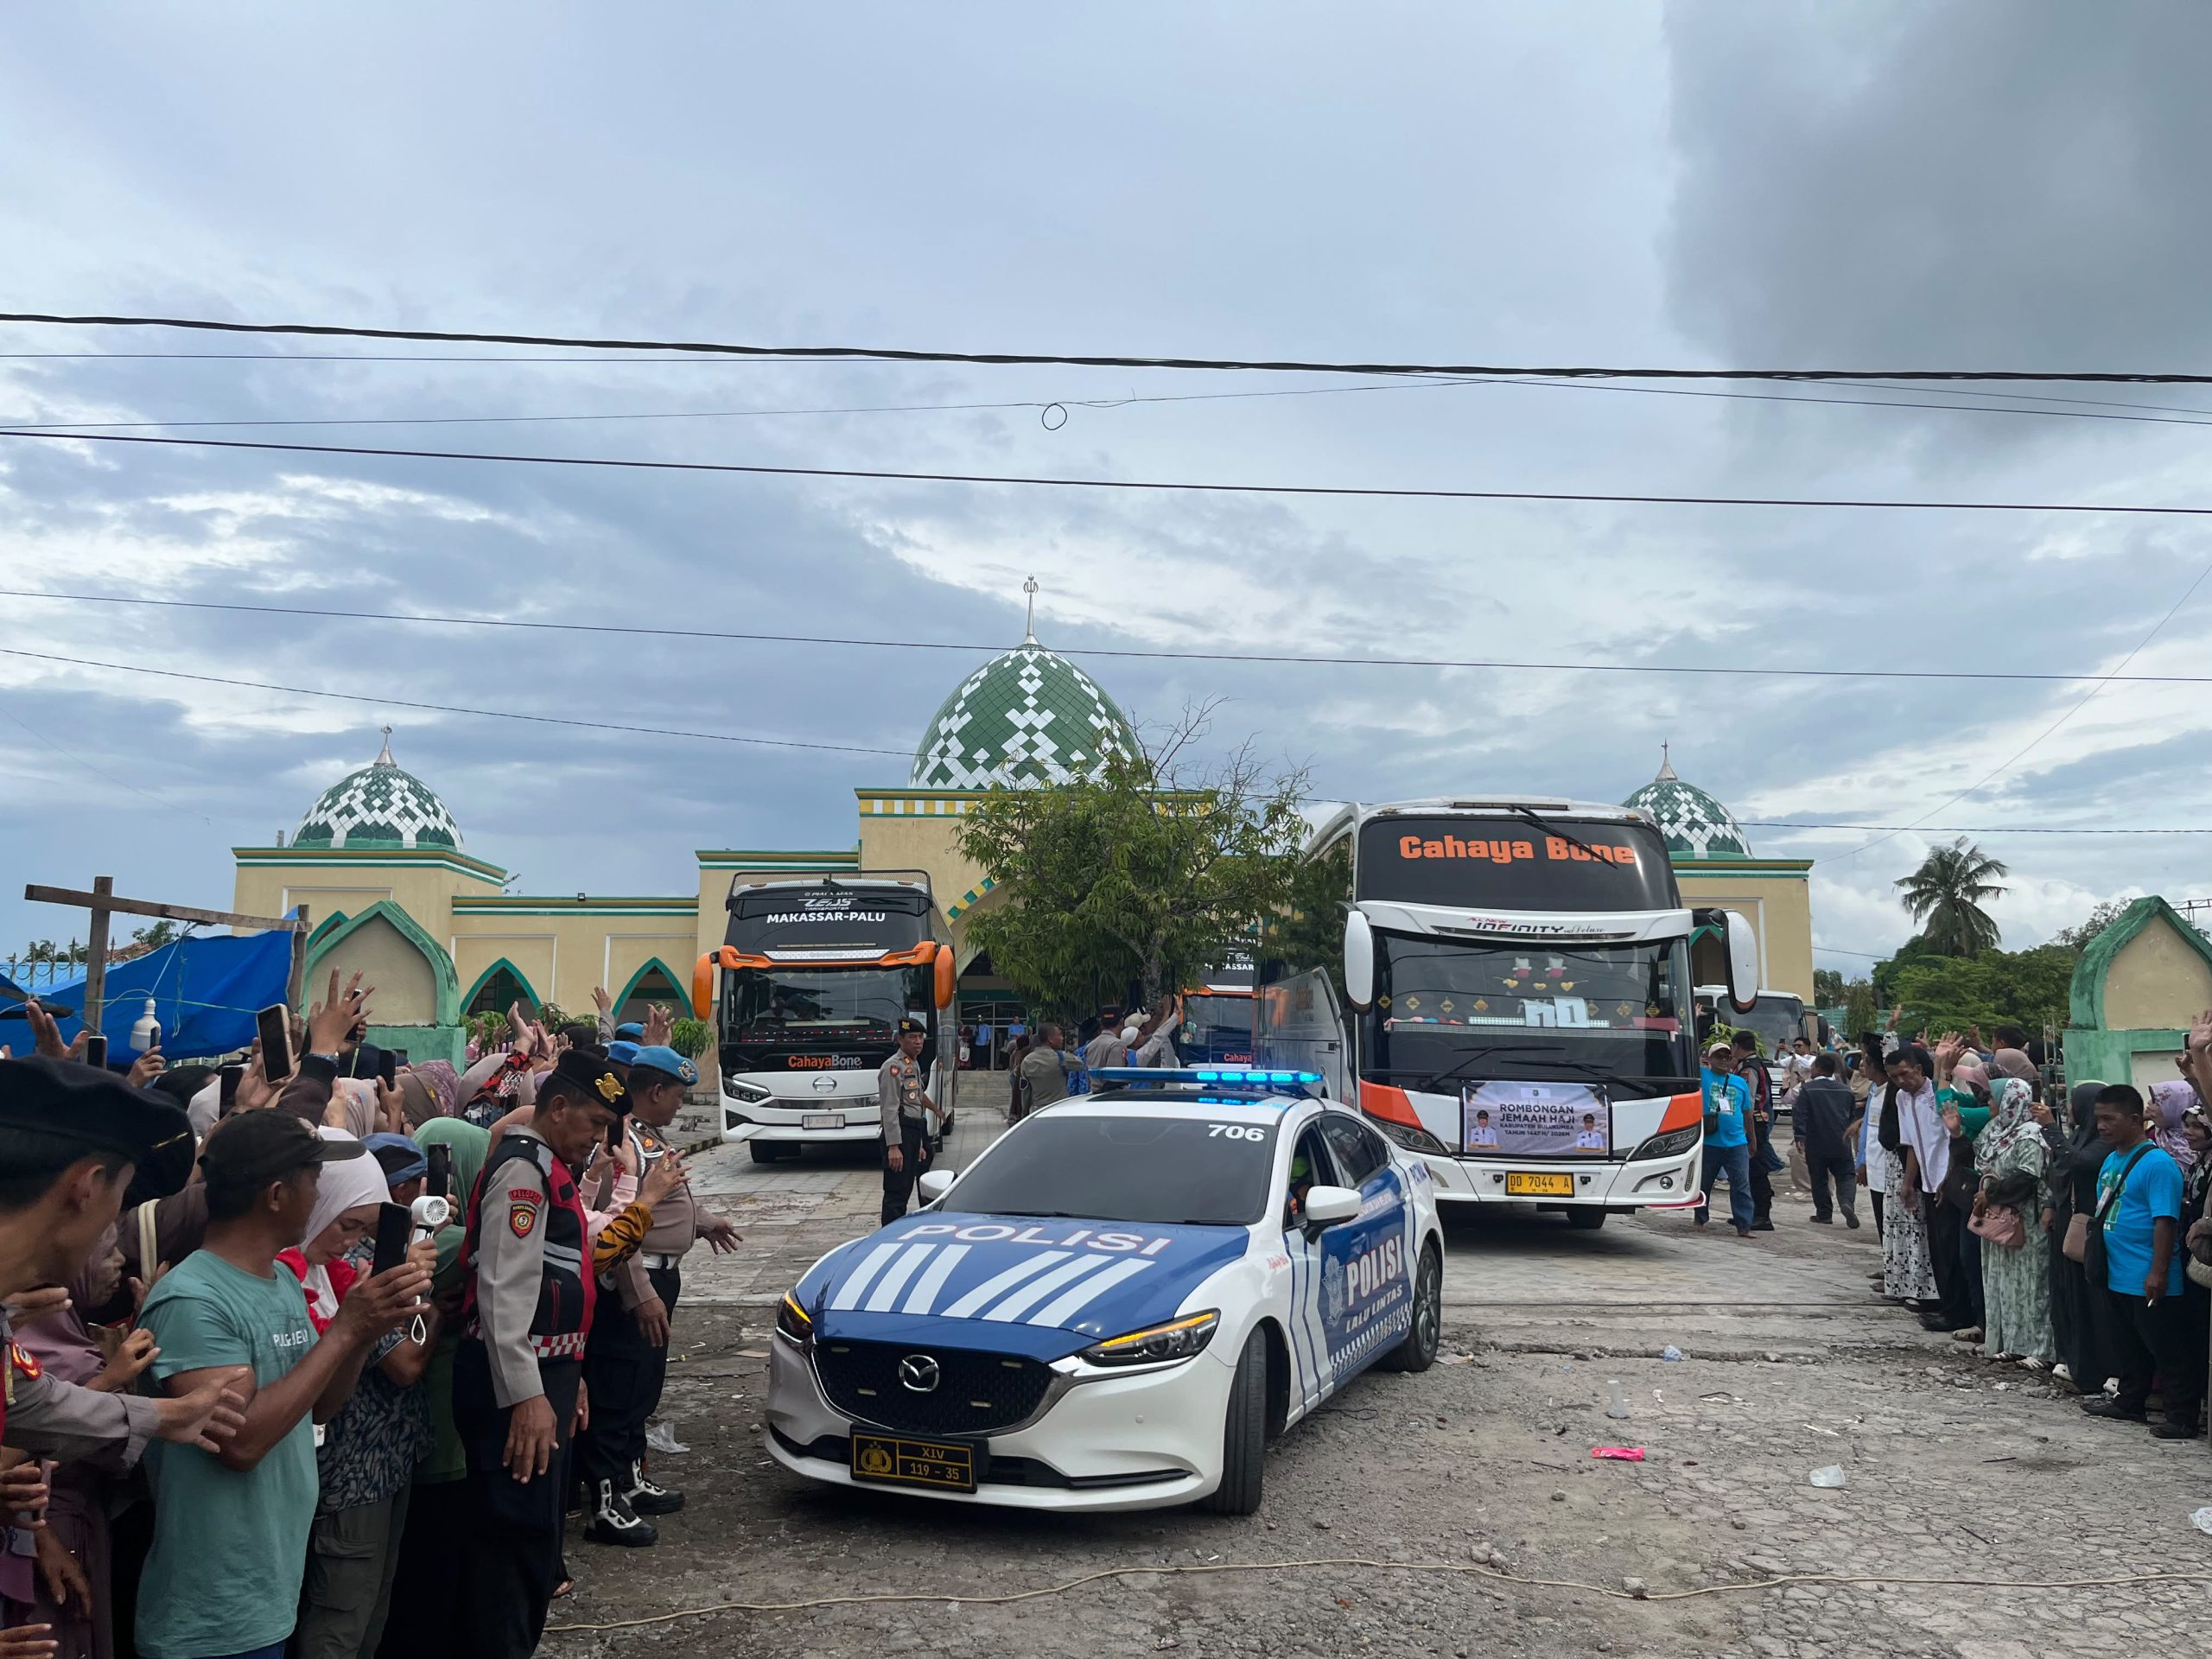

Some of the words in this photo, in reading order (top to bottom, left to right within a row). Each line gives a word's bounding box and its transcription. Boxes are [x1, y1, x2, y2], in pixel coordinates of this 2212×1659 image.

[1399, 835, 1535, 864] Cahaya
[1545, 836, 1637, 864] Bone
[766, 912, 886, 924] MAKASSAR-PALU
[788, 1055, 863, 1069] CahayaBone
[1499, 1103, 1574, 1114] ROMBONGAN
[1499, 1113, 1547, 1123] JEMAAH
[1206, 1124, 1265, 1141] 706
[1510, 1176, 1522, 1186] DD
[1529, 1176, 1554, 1188] 7044
[1564, 1177, 1570, 1189] A
[897, 1224, 1173, 1255] POLISI
[1345, 1235, 1403, 1307] POLISI
[1345, 1309, 1370, 1333] LALU
[1371, 1284, 1403, 1315] LINTAS
[922, 1447, 944, 1459] XIV
[910, 1462, 930, 1476] 119
[945, 1467, 960, 1480] 35
